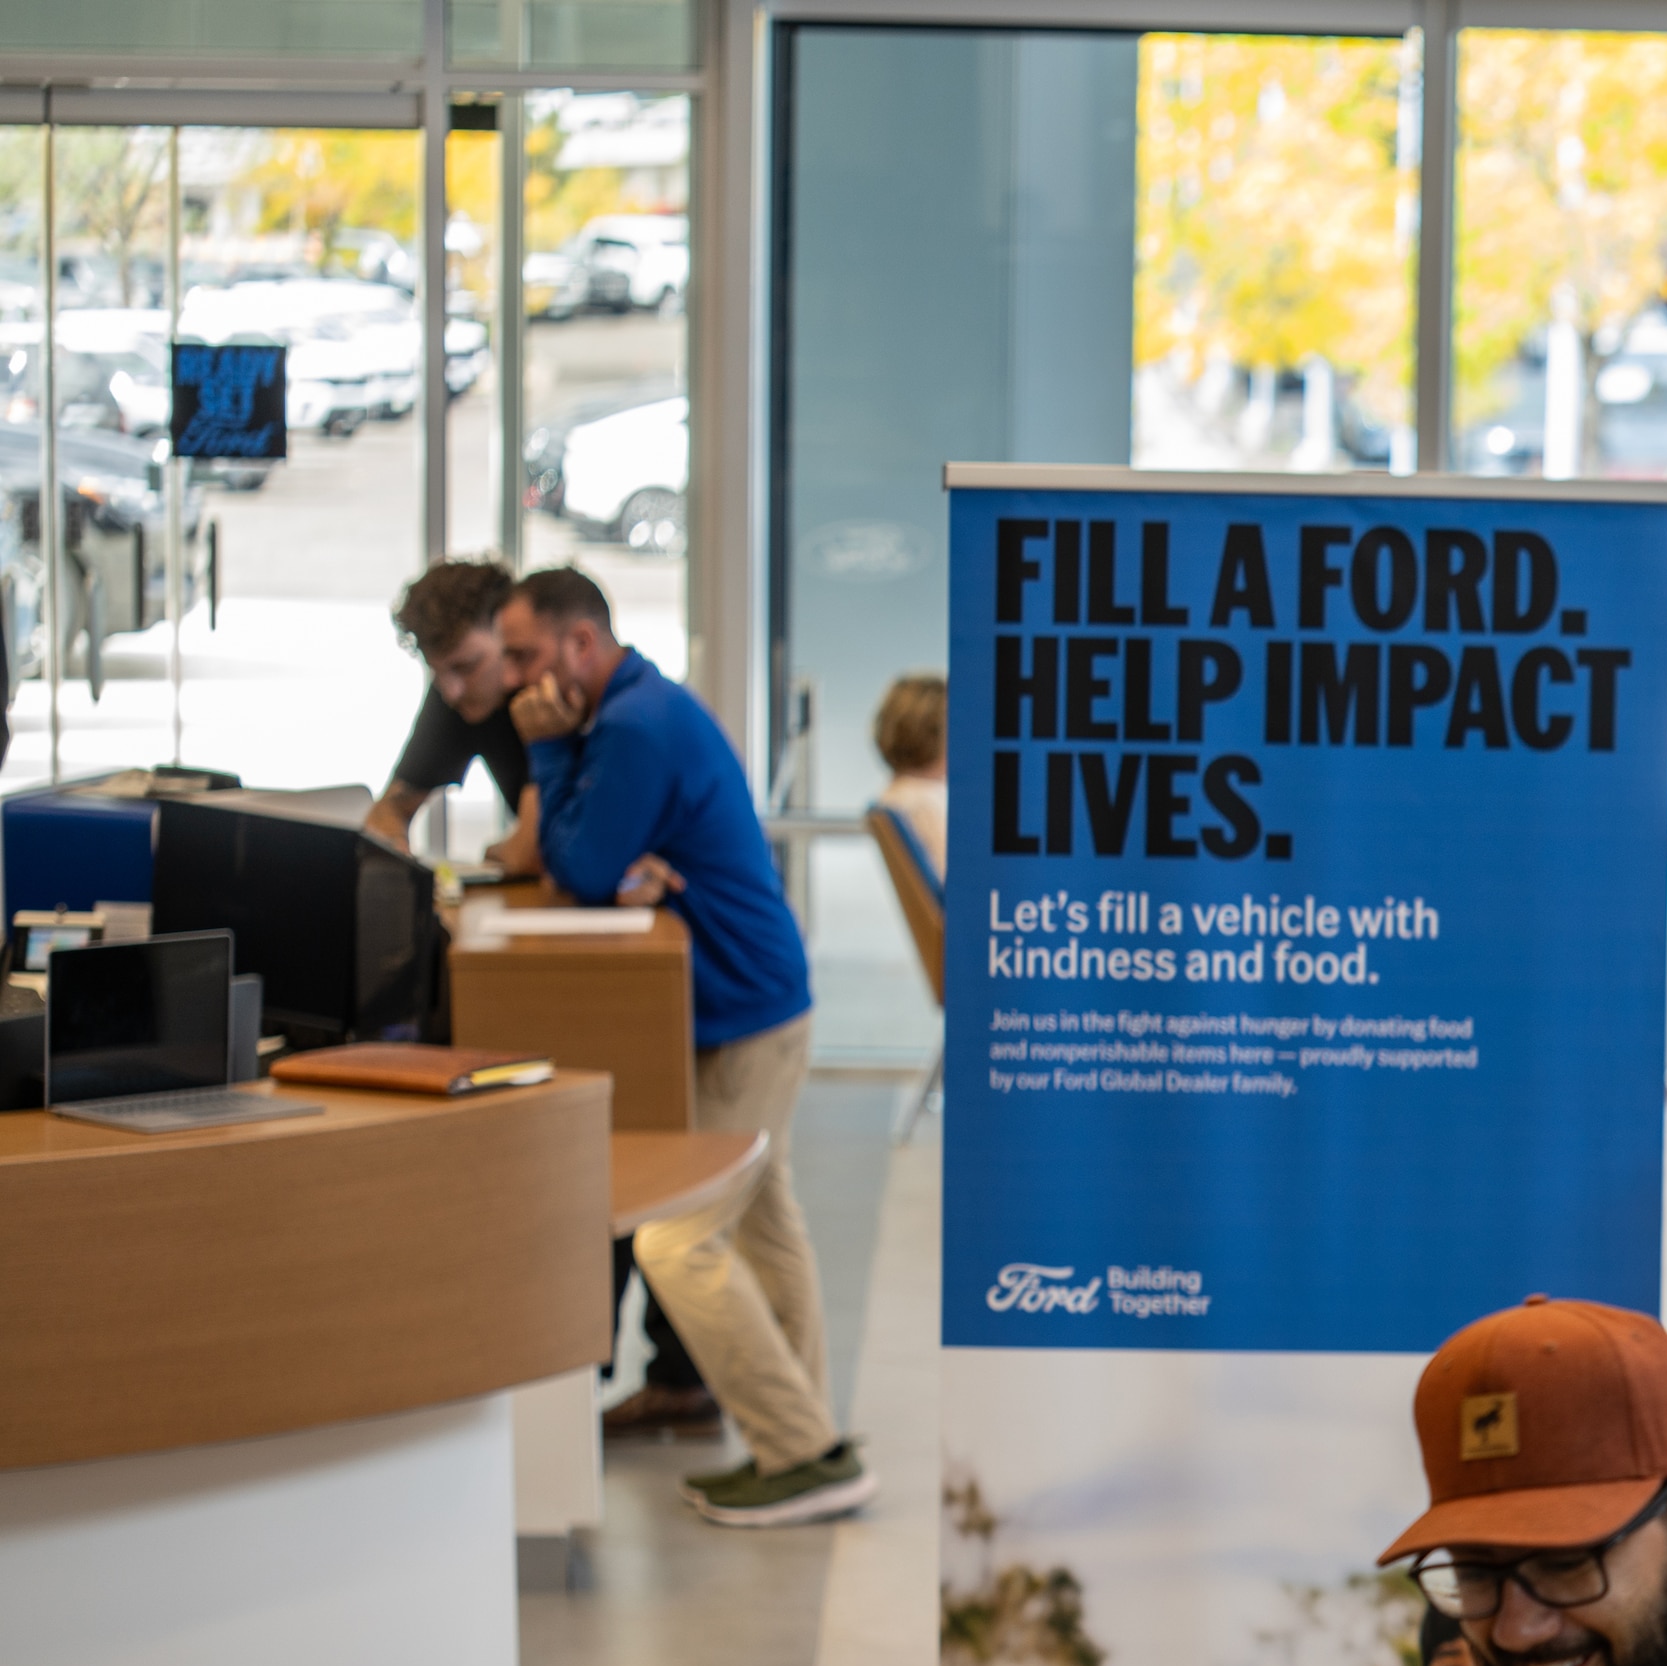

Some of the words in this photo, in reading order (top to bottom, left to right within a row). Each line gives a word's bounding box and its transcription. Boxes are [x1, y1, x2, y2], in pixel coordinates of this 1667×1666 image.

[995, 518, 1189, 628] FILL
[1209, 522, 1276, 629] A
[1297, 524, 1588, 636] FORD.
[993, 635, 1244, 743] HELP
[1264, 640, 1633, 752] IMPACT
[992, 750, 1293, 861] LIVES.
[988, 890, 1090, 934] Let's
[1096, 891, 1150, 935] fill
[1157, 901, 1183, 935] a
[1192, 893, 1341, 938] vehicle
[1348, 896, 1439, 940] with
[988, 936, 1178, 982] kindness
[1185, 939, 1265, 983] and
[1273, 940, 1380, 985] food.
[989, 1009, 1031, 1033] Join
[1033, 1015, 1057, 1033] us
[1060, 1010, 1079, 1033] in
[1082, 1011, 1115, 1034] the
[1117, 1011, 1163, 1038] fight
[1165, 1013, 1237, 1038] against
[1239, 1014, 1310, 1040] hunger
[1312, 1015, 1336, 1041] by
[1339, 1016, 1427, 1042] donating
[1428, 1016, 1474, 1040] food
[989, 1040, 1027, 1062] and
[1030, 1041, 1169, 1066] nonperishable
[1171, 1042, 1227, 1064] items
[1229, 1043, 1275, 1065] here
[1300, 1045, 1375, 1071] proudly
[1377, 1046, 1478, 1070] supported
[989, 1068, 1014, 1093] by
[1016, 1073, 1049, 1091] our
[1053, 1068, 1098, 1092] Ford
[1100, 1069, 1163, 1093] Global
[1165, 1070, 1229, 1094] Dealer
[1231, 1071, 1299, 1098] family.
[985, 1262, 1103, 1315] Ford
[1106, 1265, 1203, 1294] Building
[1107, 1291, 1212, 1319] Together
